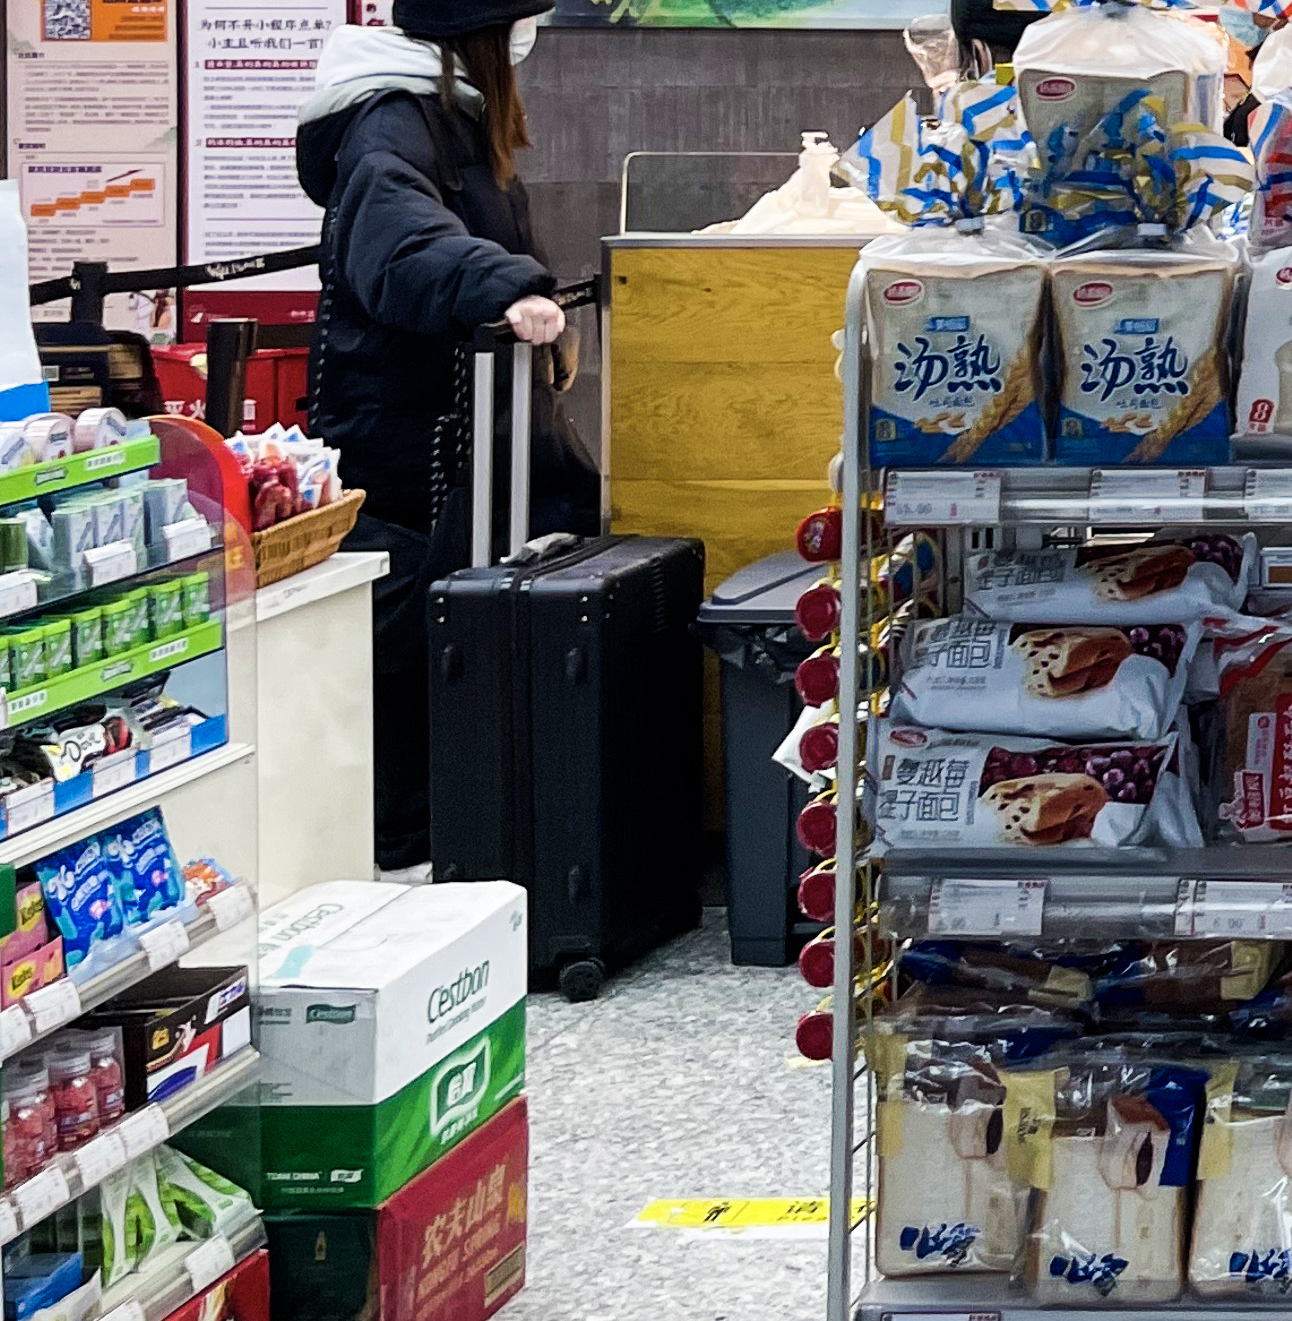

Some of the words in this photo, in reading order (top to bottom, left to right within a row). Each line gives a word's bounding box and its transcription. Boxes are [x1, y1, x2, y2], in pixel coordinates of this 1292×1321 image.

[895, 334, 1003, 401] 汤熟
[1081, 334, 1189, 401] 汤熟
[428, 959, 491, 1024] C'estbon
